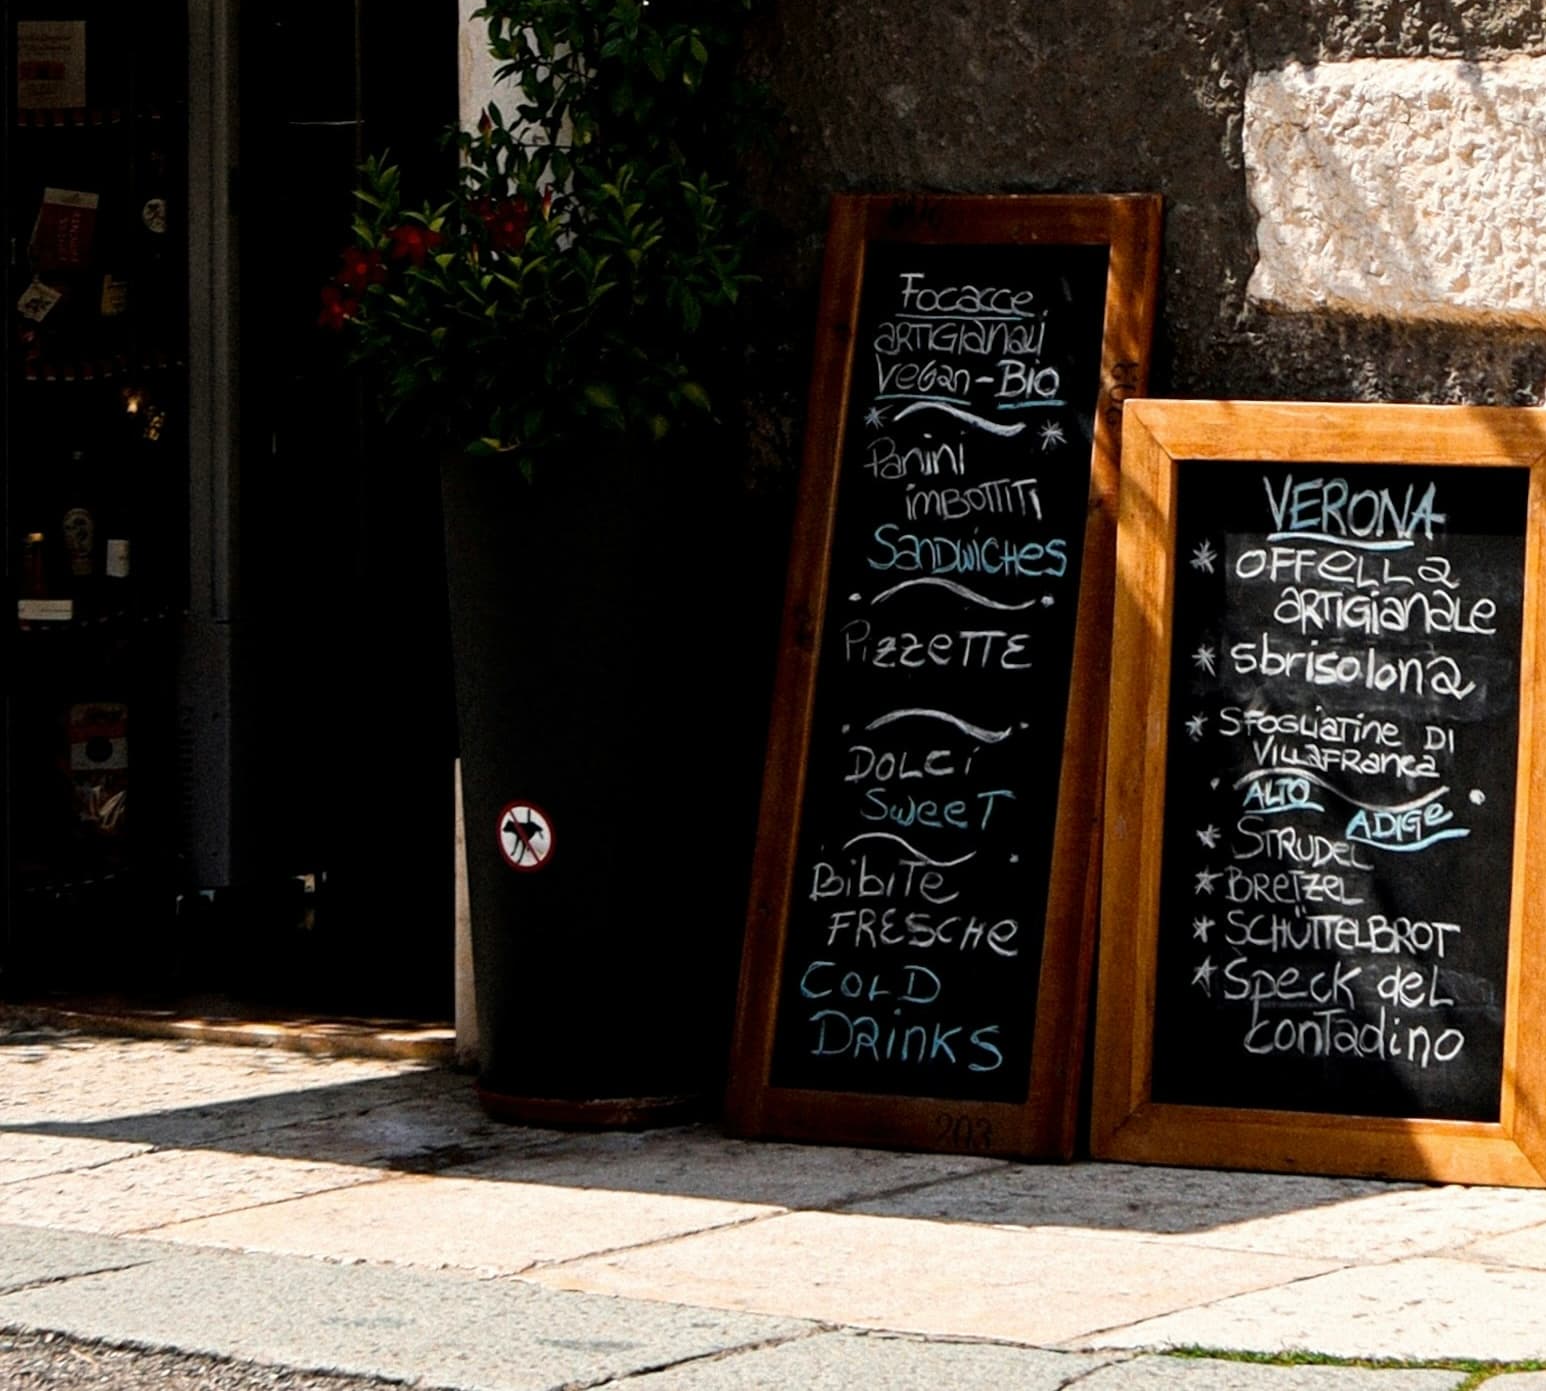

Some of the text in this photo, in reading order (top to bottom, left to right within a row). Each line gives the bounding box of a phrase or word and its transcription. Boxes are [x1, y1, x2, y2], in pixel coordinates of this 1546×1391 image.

[899, 272, 1035, 317] Focacce
[864, 433, 965, 479] Panini
[1262, 473, 1447, 541] VERONA
[1230, 631, 1476, 700] sbrisolona
[1242, 777, 1313, 807] ALTO
[800, 960, 942, 1004] COLD
[1223, 957, 1363, 1024] Speck
